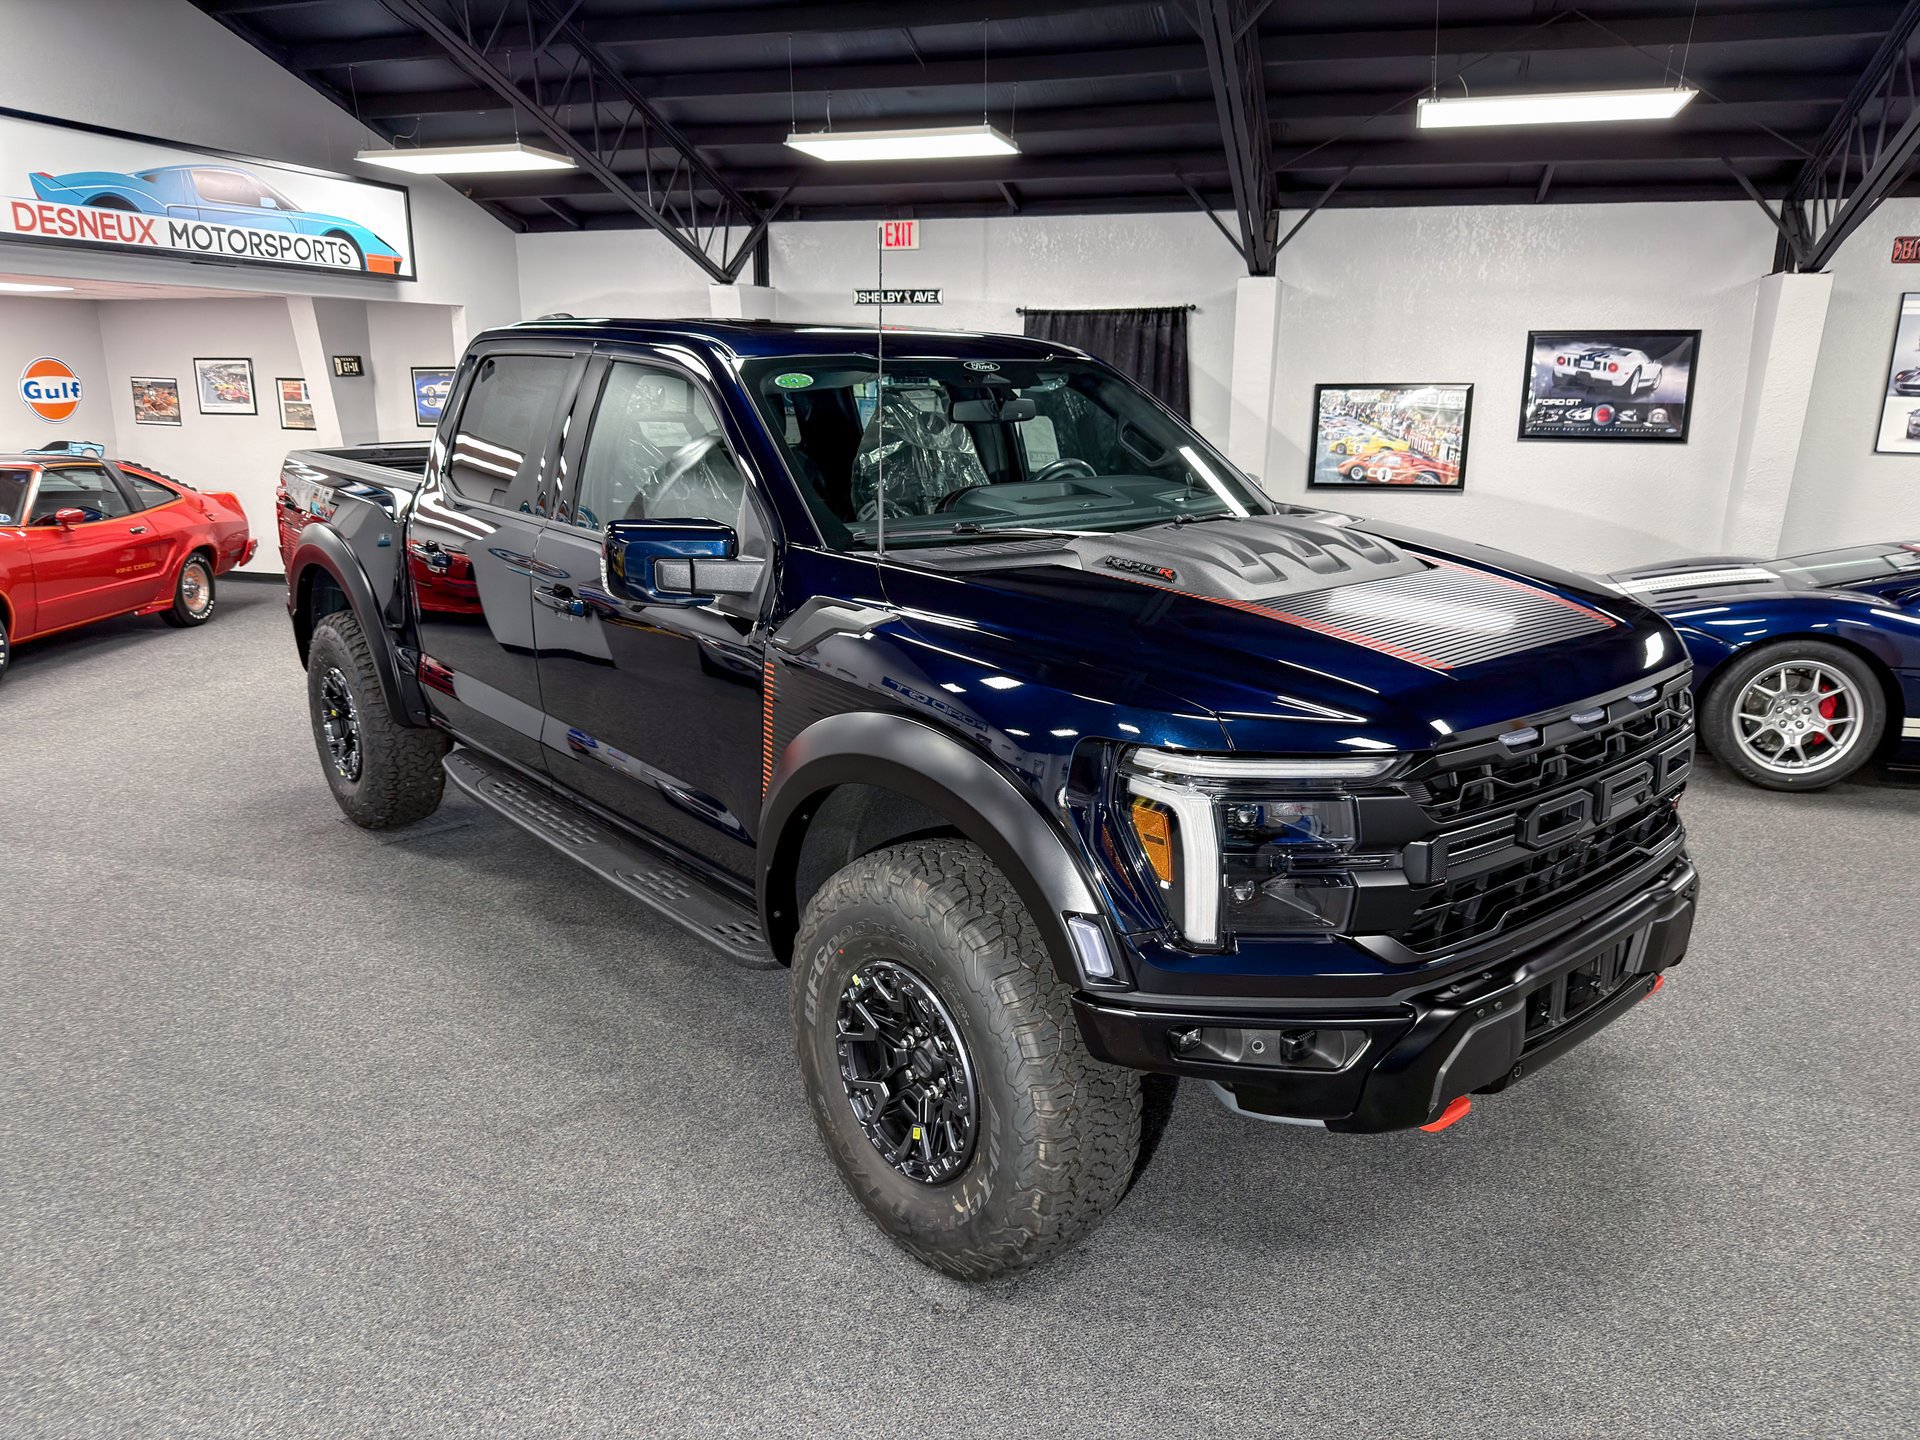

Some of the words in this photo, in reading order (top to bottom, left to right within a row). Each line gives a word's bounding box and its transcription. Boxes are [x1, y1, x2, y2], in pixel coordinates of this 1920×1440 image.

[11, 201, 158, 245] DESNEUX
[168, 220, 351, 265] MOTORSPORTS
[885, 222, 913, 247] EXIT
[859, 291, 903, 303] SHELBY
[970, 362, 995, 370] Ford
[23, 381, 80, 399] Gulf
[1105, 556, 1174, 581] RAPTOR
[1428, 732, 1695, 885] FORD
